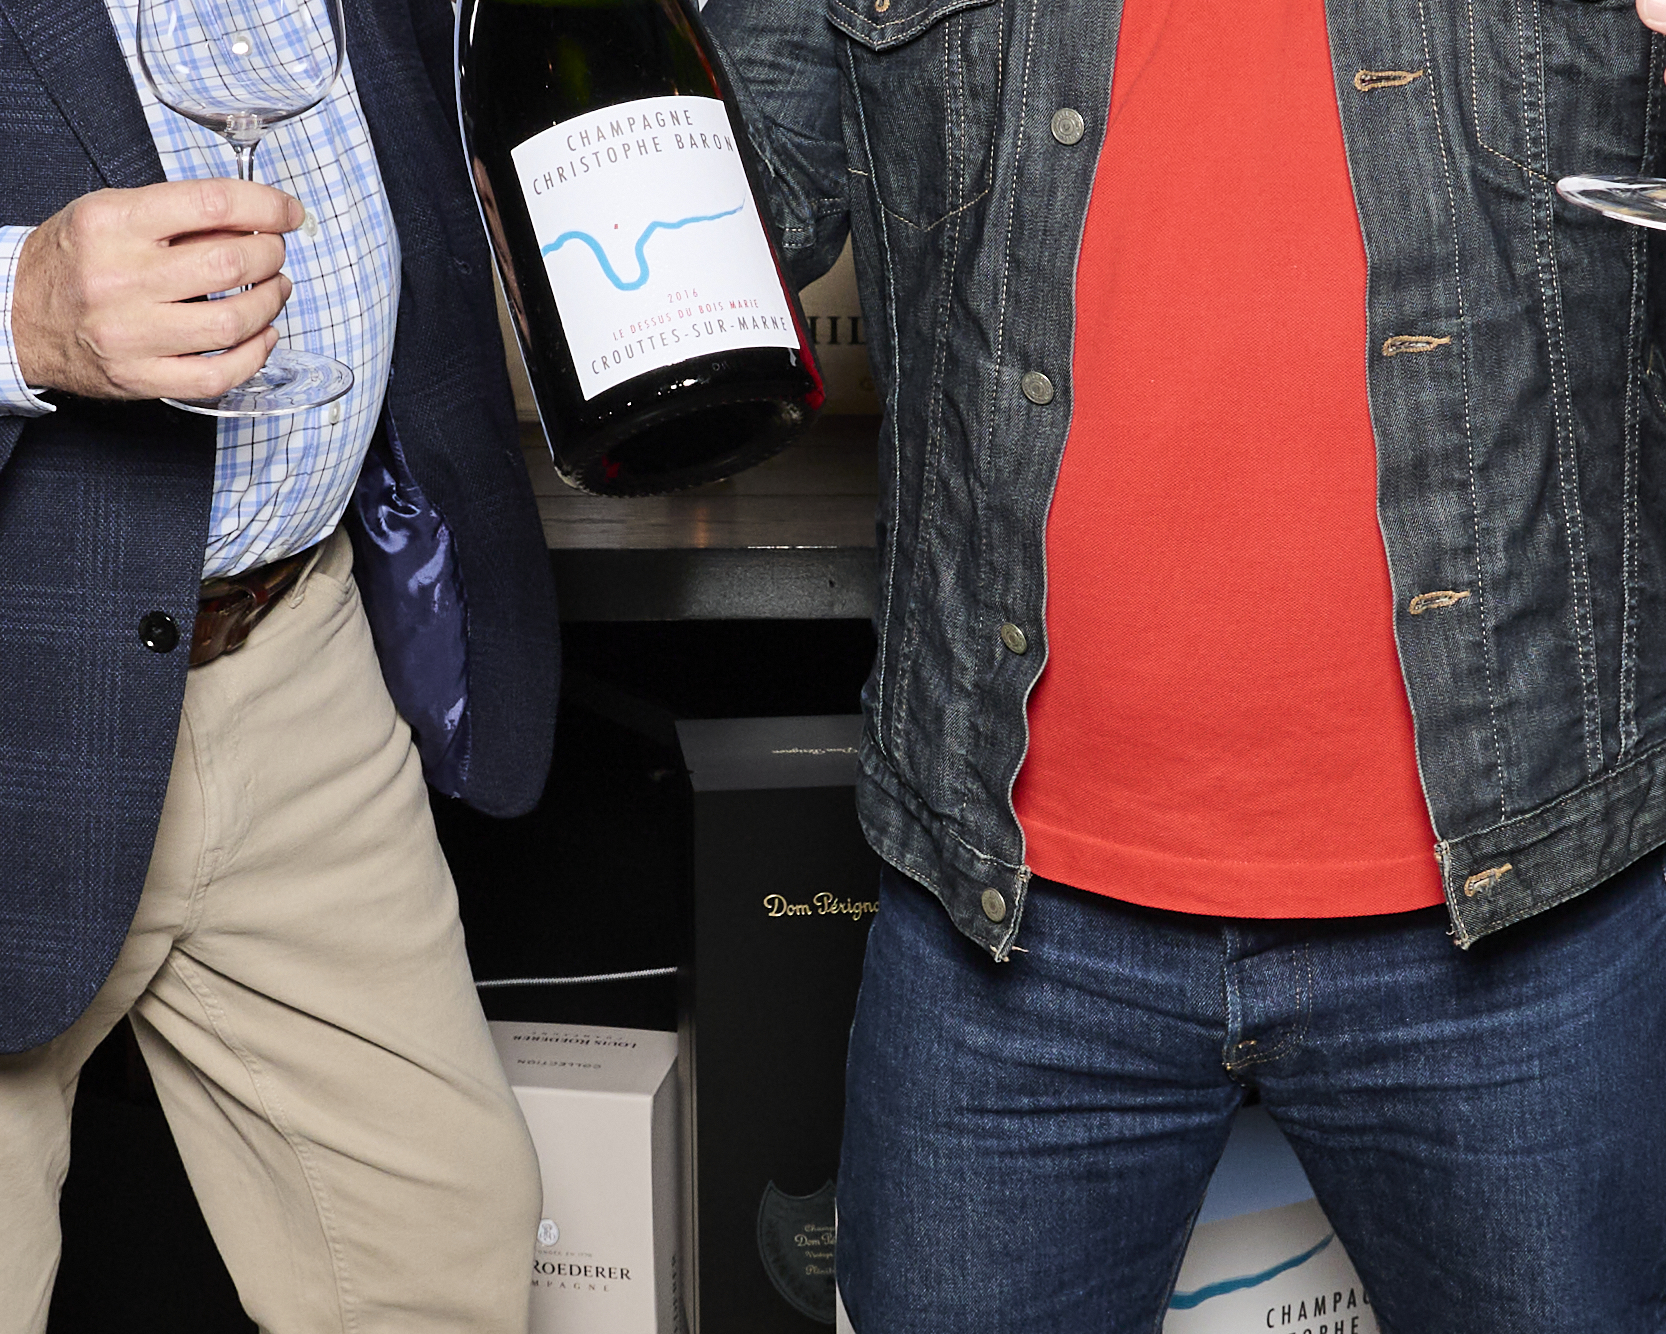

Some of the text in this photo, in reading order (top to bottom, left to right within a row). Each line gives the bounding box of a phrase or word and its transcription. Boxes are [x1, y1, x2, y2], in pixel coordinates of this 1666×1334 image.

[567, 109, 694, 152] CHAMPAGNE
[533, 132, 734, 196] CHRISTOPHE BARON
[667, 288, 699, 304] 2016
[612, 328, 625, 341] LE
[630, 312, 673, 334] DESSUS
[678, 308, 693, 319] DU
[698, 301, 725, 315] BOIS
[591, 315, 789, 375] CROUTTES-SUR-MARNE
[763, 892, 880, 921] Dom Périgno
[532, 1259, 632, 1281] ROEDERER
[532, 1280, 610, 1293] MPAGNE
[1266, 1287, 1370, 1329] CHAMPA
